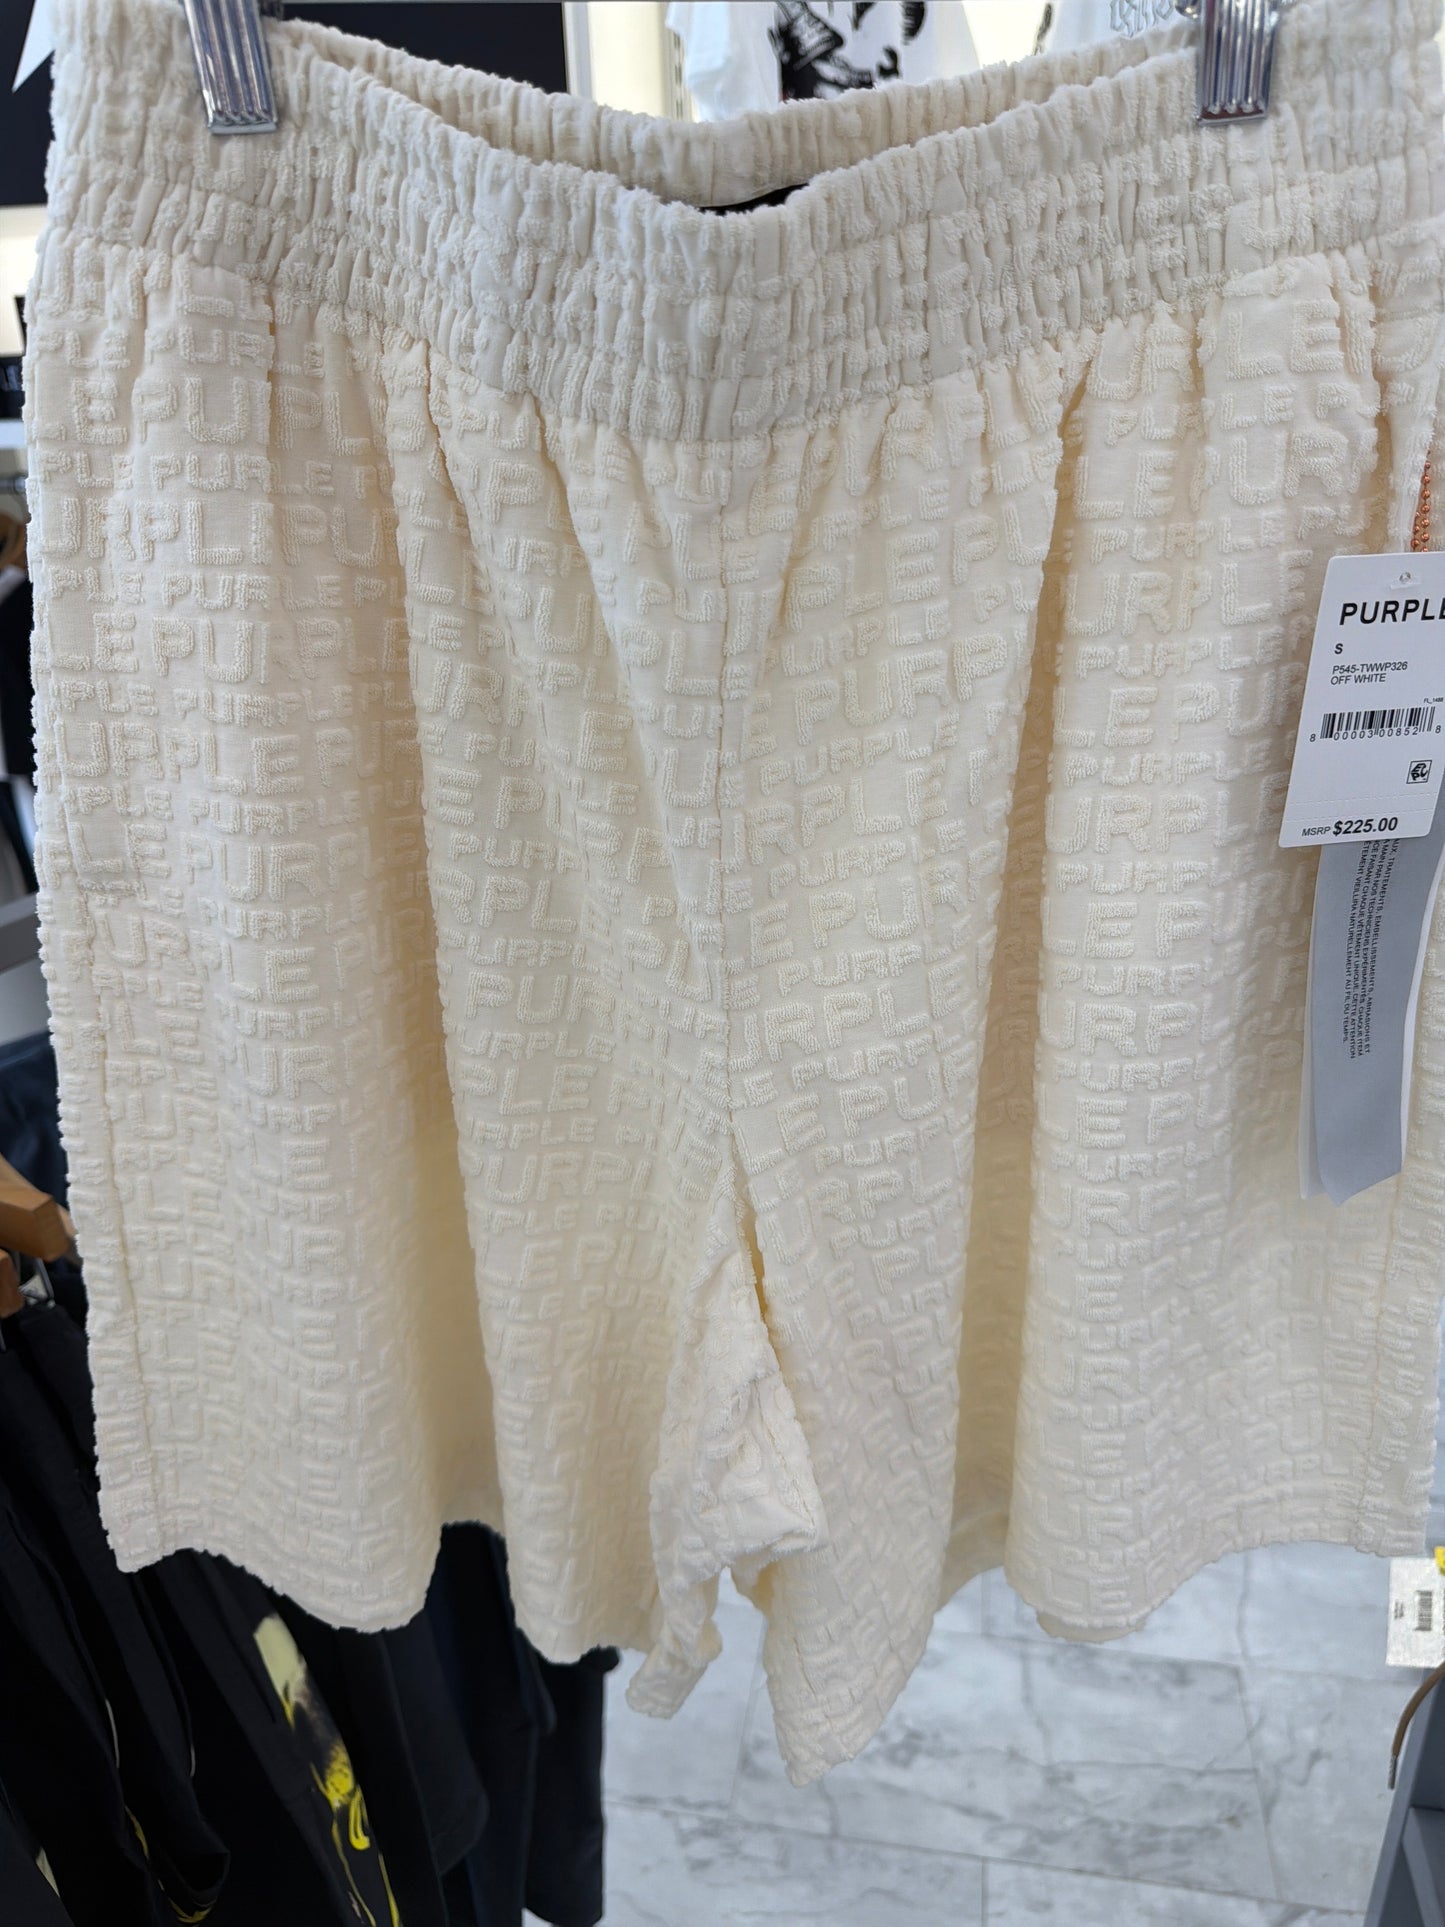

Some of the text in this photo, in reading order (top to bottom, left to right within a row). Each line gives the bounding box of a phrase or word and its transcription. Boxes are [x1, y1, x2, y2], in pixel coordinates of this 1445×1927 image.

[1334, 643, 1343, 655] S
[1332, 661, 1408, 675] P545-TWWP326
[1330, 673, 1386, 685] OFF WHITE
[1302, 817, 1399, 837] MSRP $225.00
